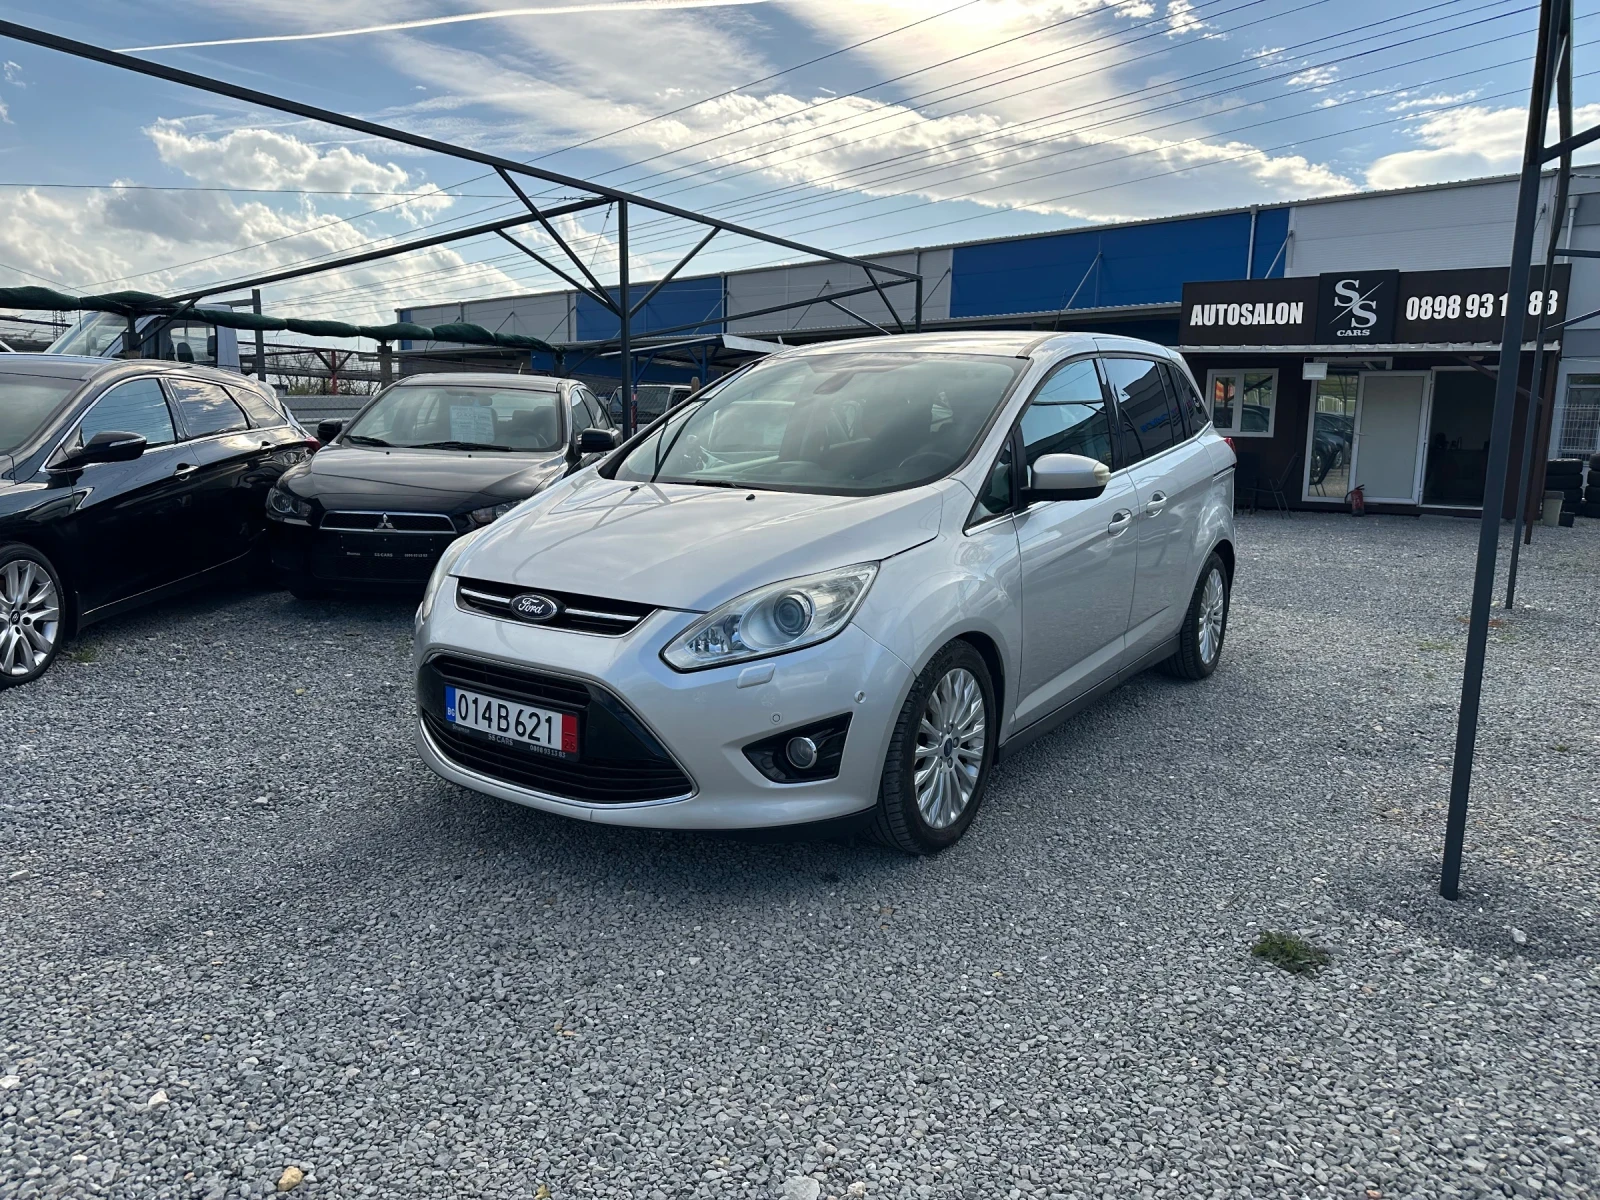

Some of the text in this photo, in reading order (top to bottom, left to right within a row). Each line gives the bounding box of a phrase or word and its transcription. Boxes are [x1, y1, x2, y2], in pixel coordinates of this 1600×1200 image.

[1189, 301, 1304, 326] AUTOSALON
[1405, 295, 1461, 321] 0898
[1465, 293, 1494, 318] 93
[1528, 289, 1558, 316] 83
[1336, 329, 1371, 337] CARS
[518, 597, 545, 614] Ford
[447, 706, 456, 717] BG
